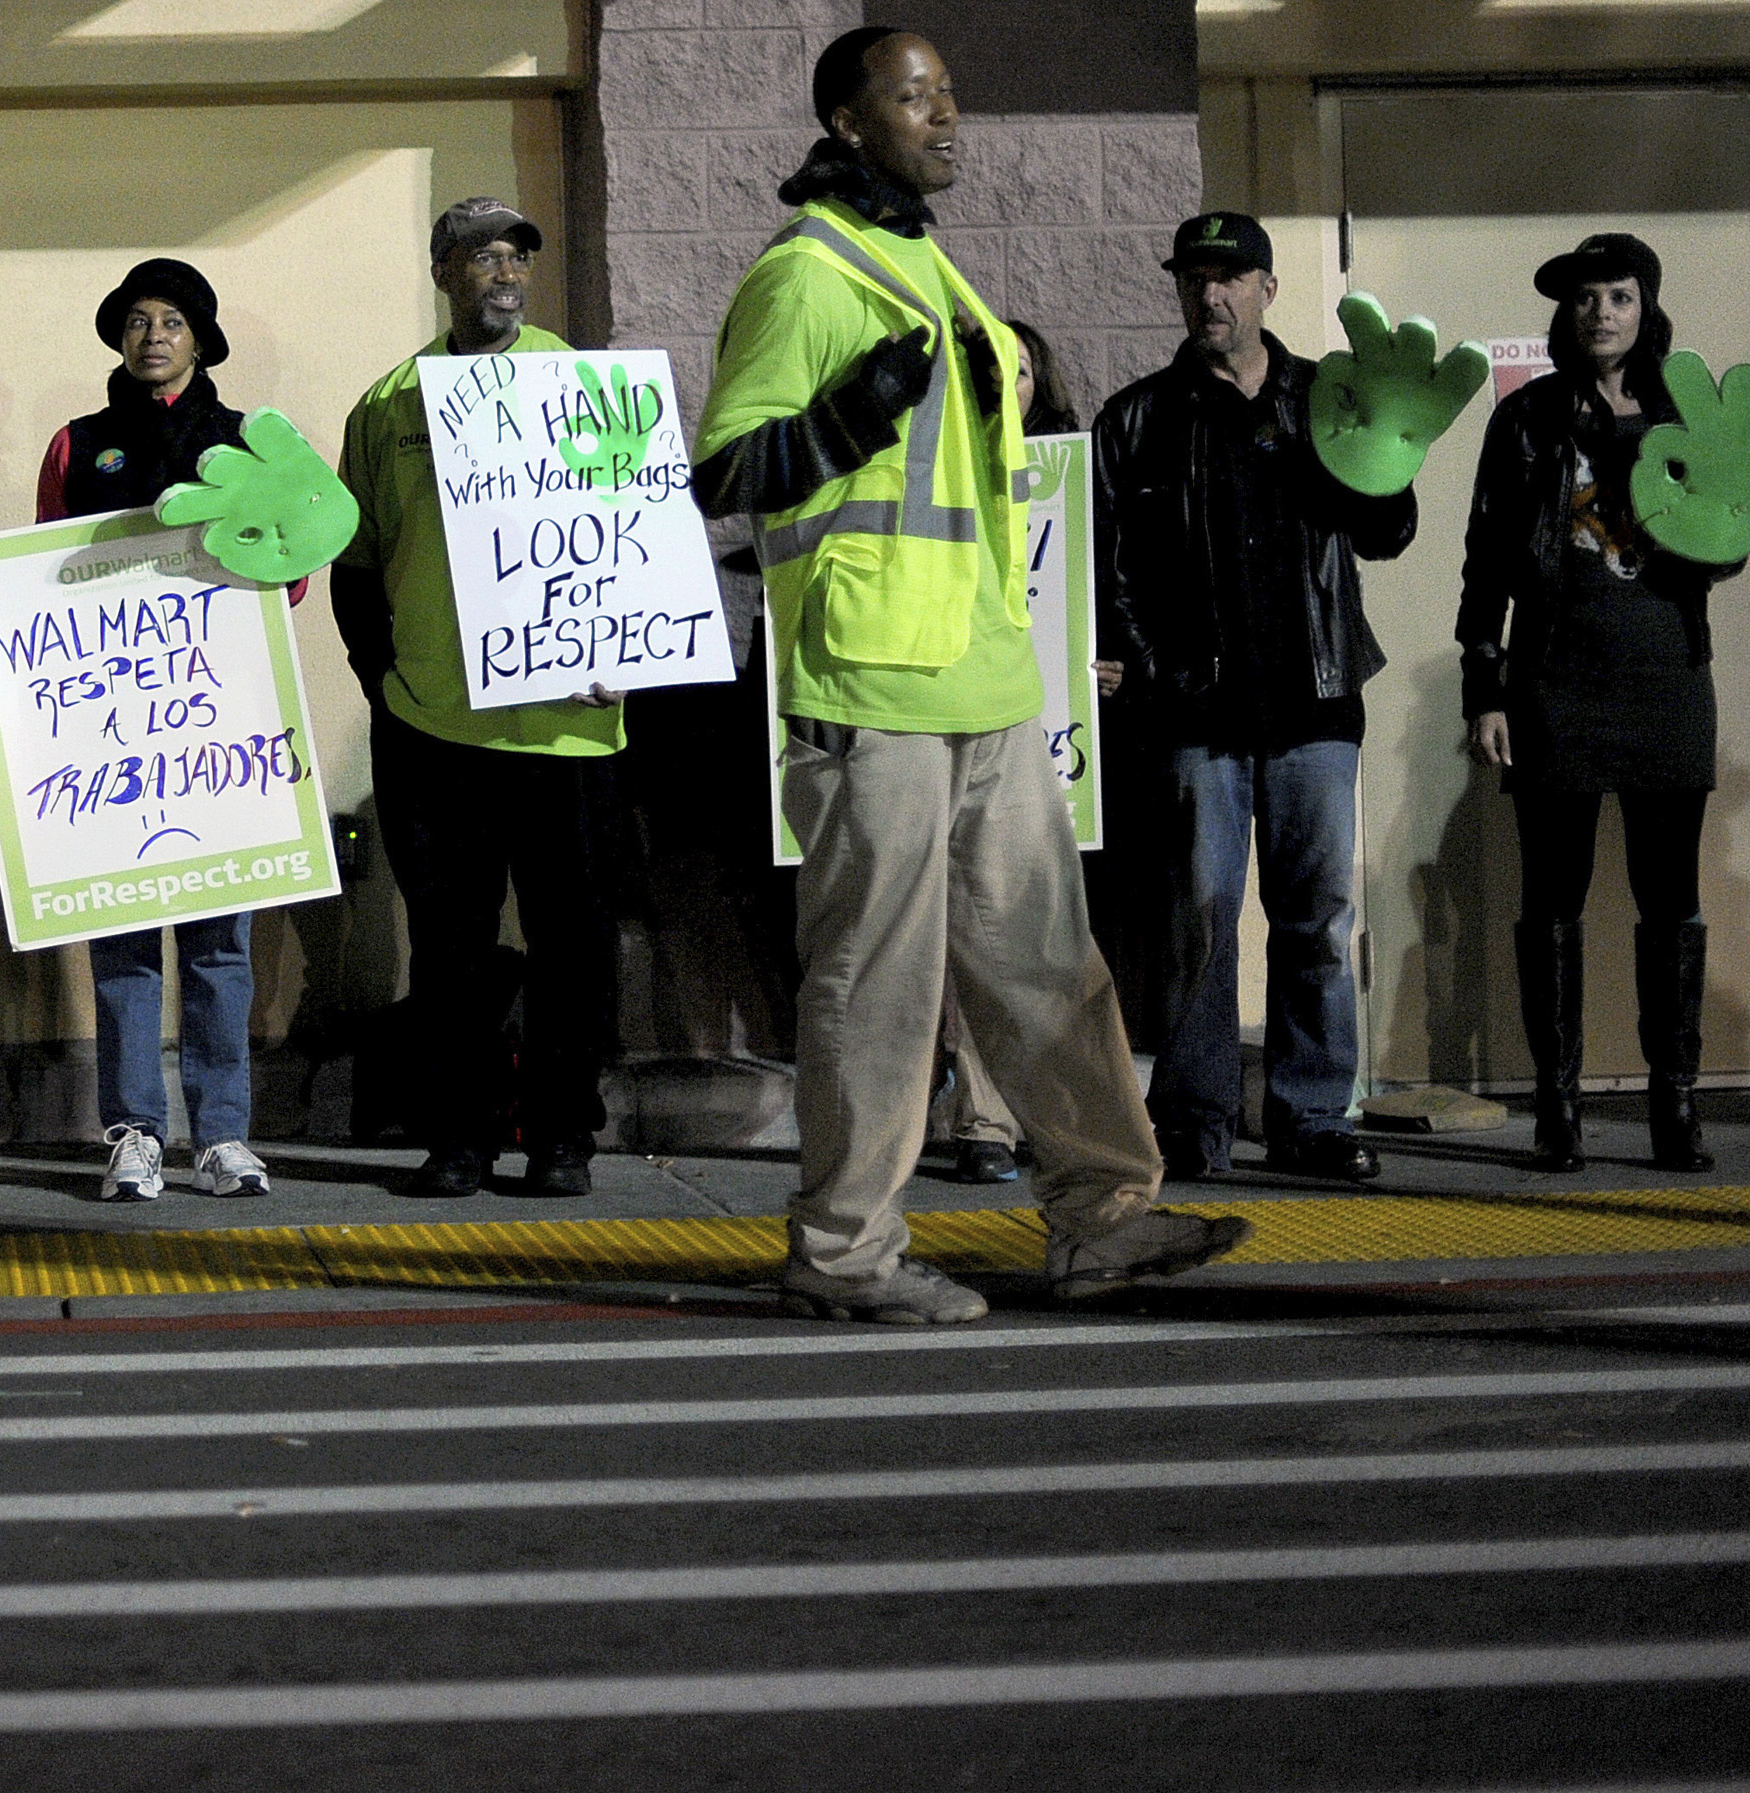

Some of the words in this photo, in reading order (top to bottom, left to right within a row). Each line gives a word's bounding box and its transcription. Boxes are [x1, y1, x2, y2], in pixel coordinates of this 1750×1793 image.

[1493, 344, 1520, 360] DO
[439, 354, 516, 440] NEED
[496, 400, 522, 443] A
[541, 383, 664, 447] HAND
[445, 465, 516, 509] With
[525, 457, 603, 499] Your
[492, 510, 649, 583] LOOK
[542, 570, 617, 621] For
[480, 610, 714, 690] RESPECT
[28, 647, 222, 738] RESPETA
[100, 707, 129, 746] A
[147, 692, 216, 735] LOS
[31, 850, 312, 921] ForRespect.org
